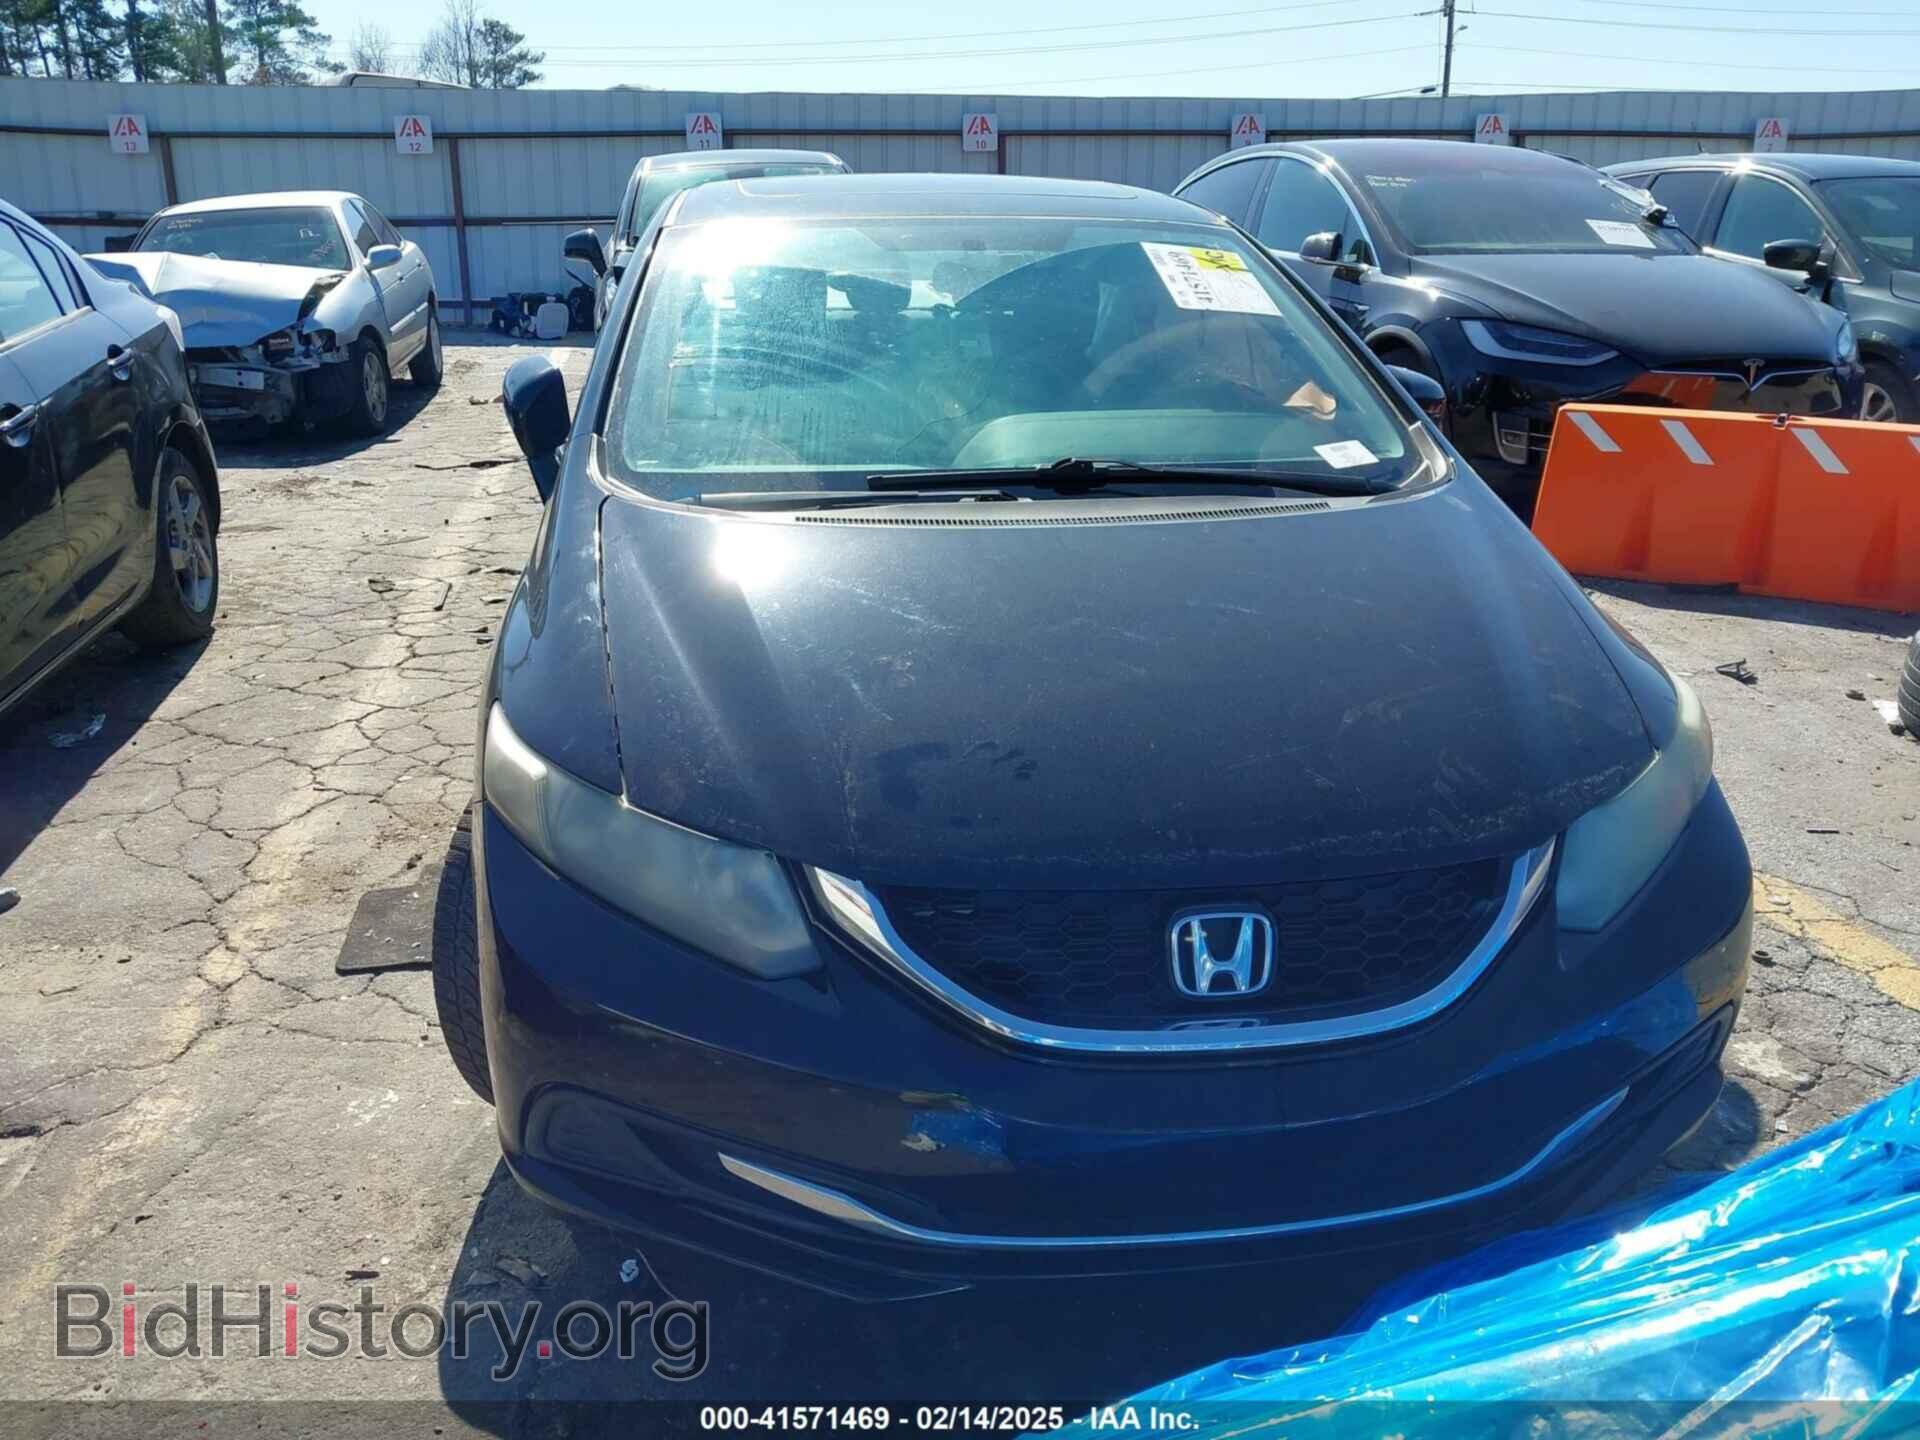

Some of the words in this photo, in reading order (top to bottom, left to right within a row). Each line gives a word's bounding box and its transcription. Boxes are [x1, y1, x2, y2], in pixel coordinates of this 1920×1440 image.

[409, 142, 423, 152] 12
[699, 139, 711, 149] 11
[975, 139, 987, 150] 10
